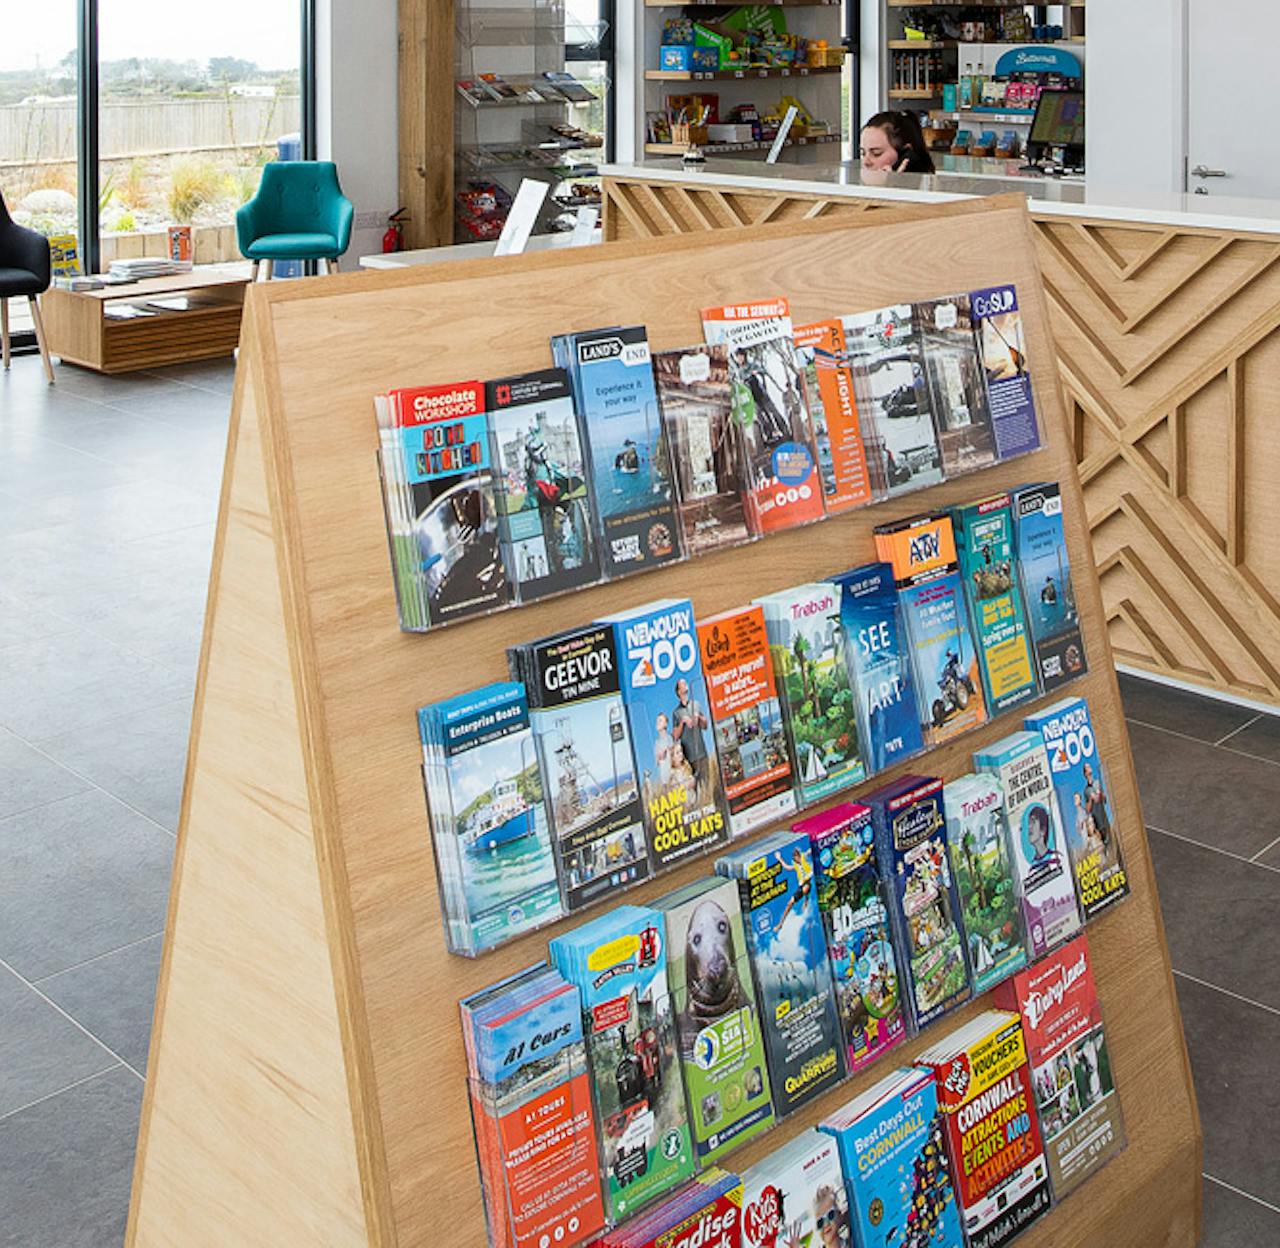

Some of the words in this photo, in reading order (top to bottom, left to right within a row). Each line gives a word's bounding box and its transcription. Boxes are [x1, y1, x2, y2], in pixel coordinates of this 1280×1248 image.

[975, 290, 1014, 316] GoSUP
[414, 390, 476, 411] Chocolate
[415, 402, 476, 422] WORKSHOPS
[416, 442, 483, 475] KITCHEN
[790, 596, 833, 619] Trebah
[626, 609, 690, 648] NEWQUAY
[858, 620, 892, 655] SEE
[544, 648, 612, 691] GEEVOR
[628, 633, 697, 688] ZOO
[563, 686, 578, 699] TIN
[578, 677, 601, 695] MINE
[870, 675, 903, 715] ART
[449, 714, 495, 738] Enterprise
[495, 705, 522, 722] Boats
[1043, 706, 1088, 741] NEWQUAY
[1047, 725, 1094, 772] ZOO
[649, 784, 687, 819] HANG
[656, 807, 683, 834] OUT
[654, 828, 688, 852] COOL
[691, 812, 723, 839] KATS
[504, 1041, 525, 1066] A1
[530, 1023, 571, 1052] Cars
[973, 1035, 1019, 1077] VOUCHERS
[537, 1096, 565, 1116] TOURS
[958, 1071, 1024, 1132] CORNWALL
[854, 1128, 879, 1154] Best
[879, 1111, 904, 1136] Days
[904, 1095, 924, 1116] Out
[858, 1113, 925, 1171] CORNWALL
[961, 1093, 1027, 1155] ATTRACTIONS
[963, 1130, 1005, 1176] EVENTS
[1006, 1112, 1031, 1144] AND
[969, 1132, 1035, 1199] ACTIVITIES
[750, 1193, 777, 1226] Kids
